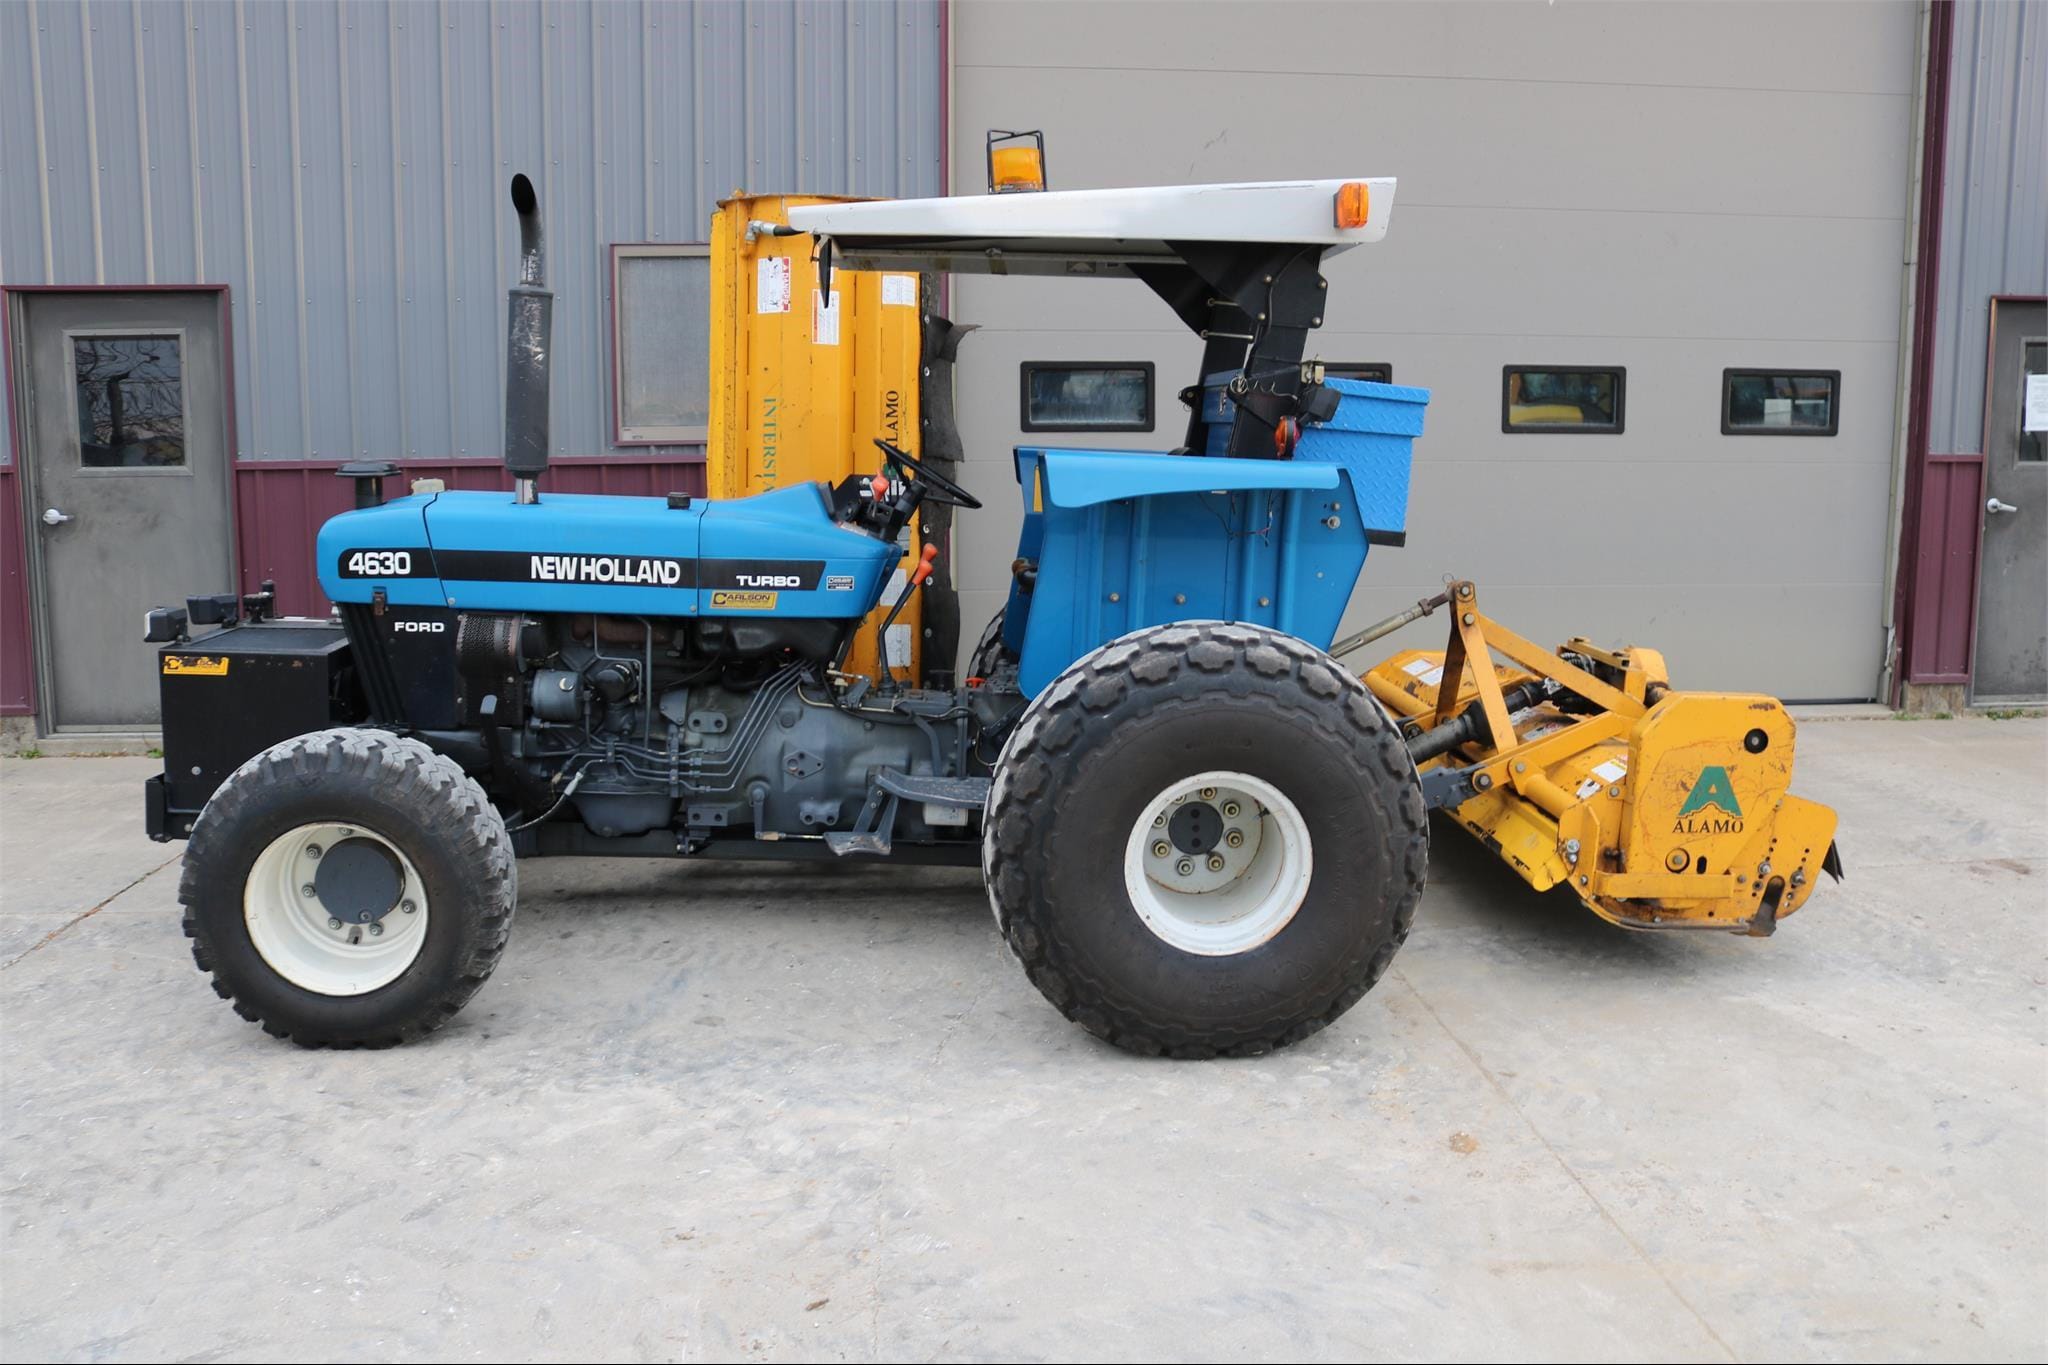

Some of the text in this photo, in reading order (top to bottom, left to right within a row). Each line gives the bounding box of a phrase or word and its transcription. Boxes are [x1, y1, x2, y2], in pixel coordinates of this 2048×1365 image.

[885, 390, 899, 449] LAMO
[348, 551, 411, 575] 4630
[530, 555, 681, 585] NEW HOLLAND
[736, 575, 801, 588] TURBO
[713, 592, 771, 606] CARLSON
[394, 621, 445, 633] FORD
[1672, 819, 1745, 834] ALAMO
